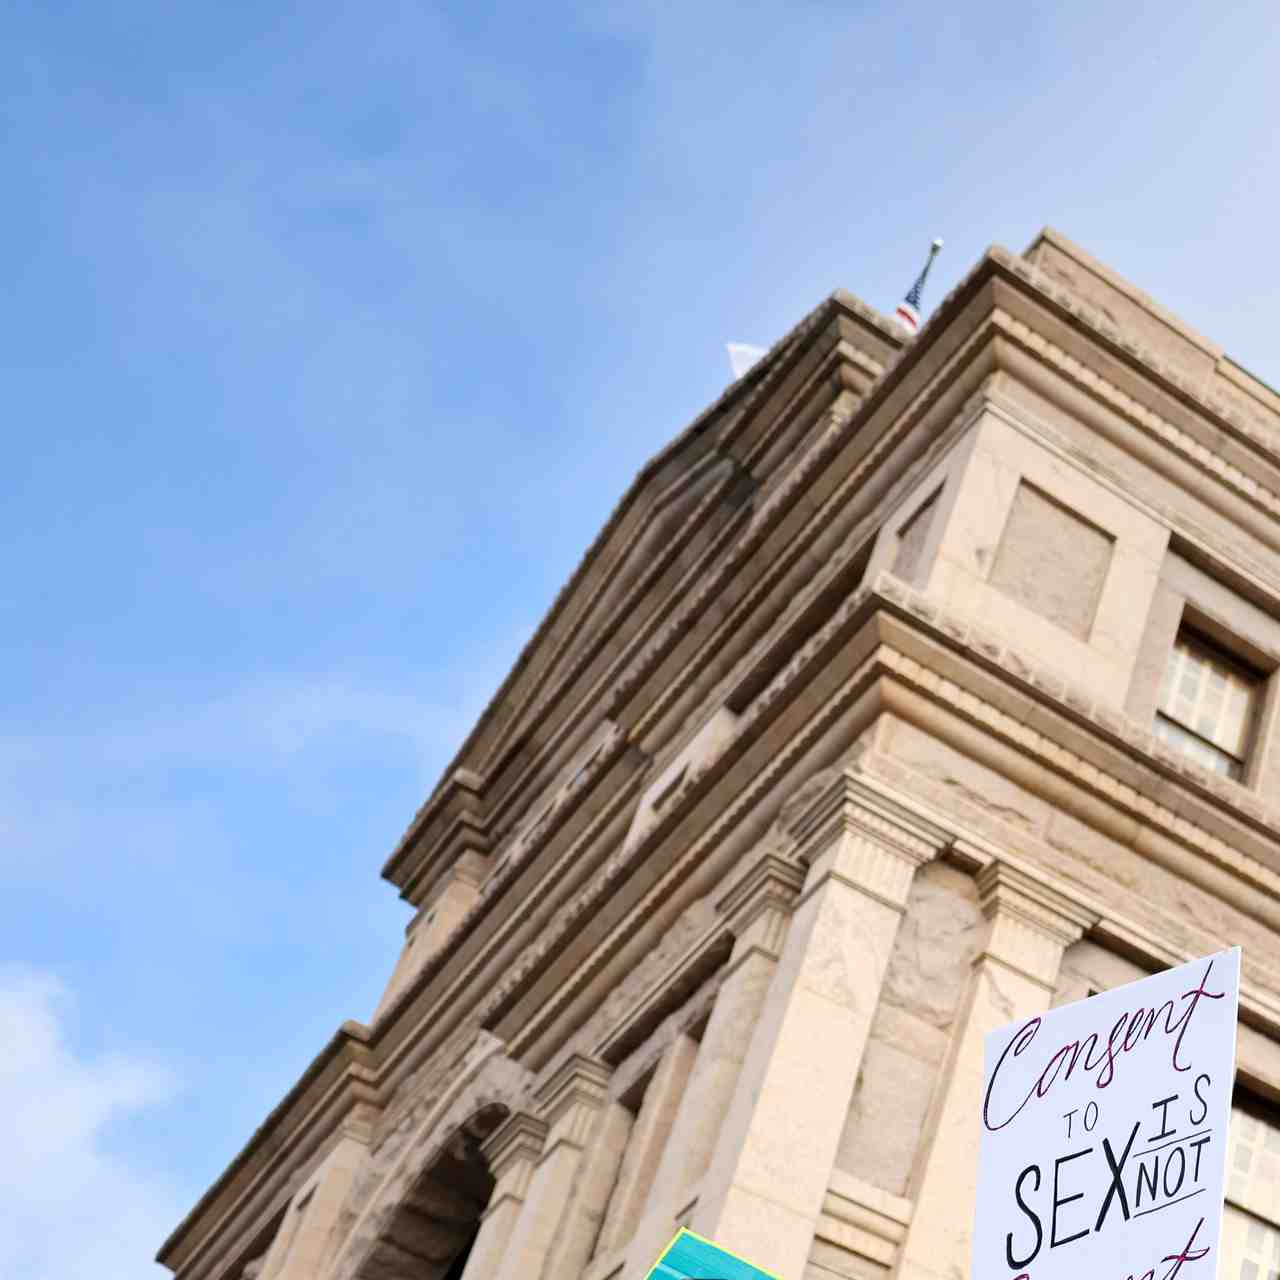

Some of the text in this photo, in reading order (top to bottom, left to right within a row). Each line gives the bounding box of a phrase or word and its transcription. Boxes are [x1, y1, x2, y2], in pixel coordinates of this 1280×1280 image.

[984, 959, 1225, 1131] Consent
[1063, 1101, 1098, 1138] TO
[1148, 1074, 1211, 1142] IS
[1006, 1121, 1140, 1270] SEX
[1135, 1137, 1210, 1207] NOT
